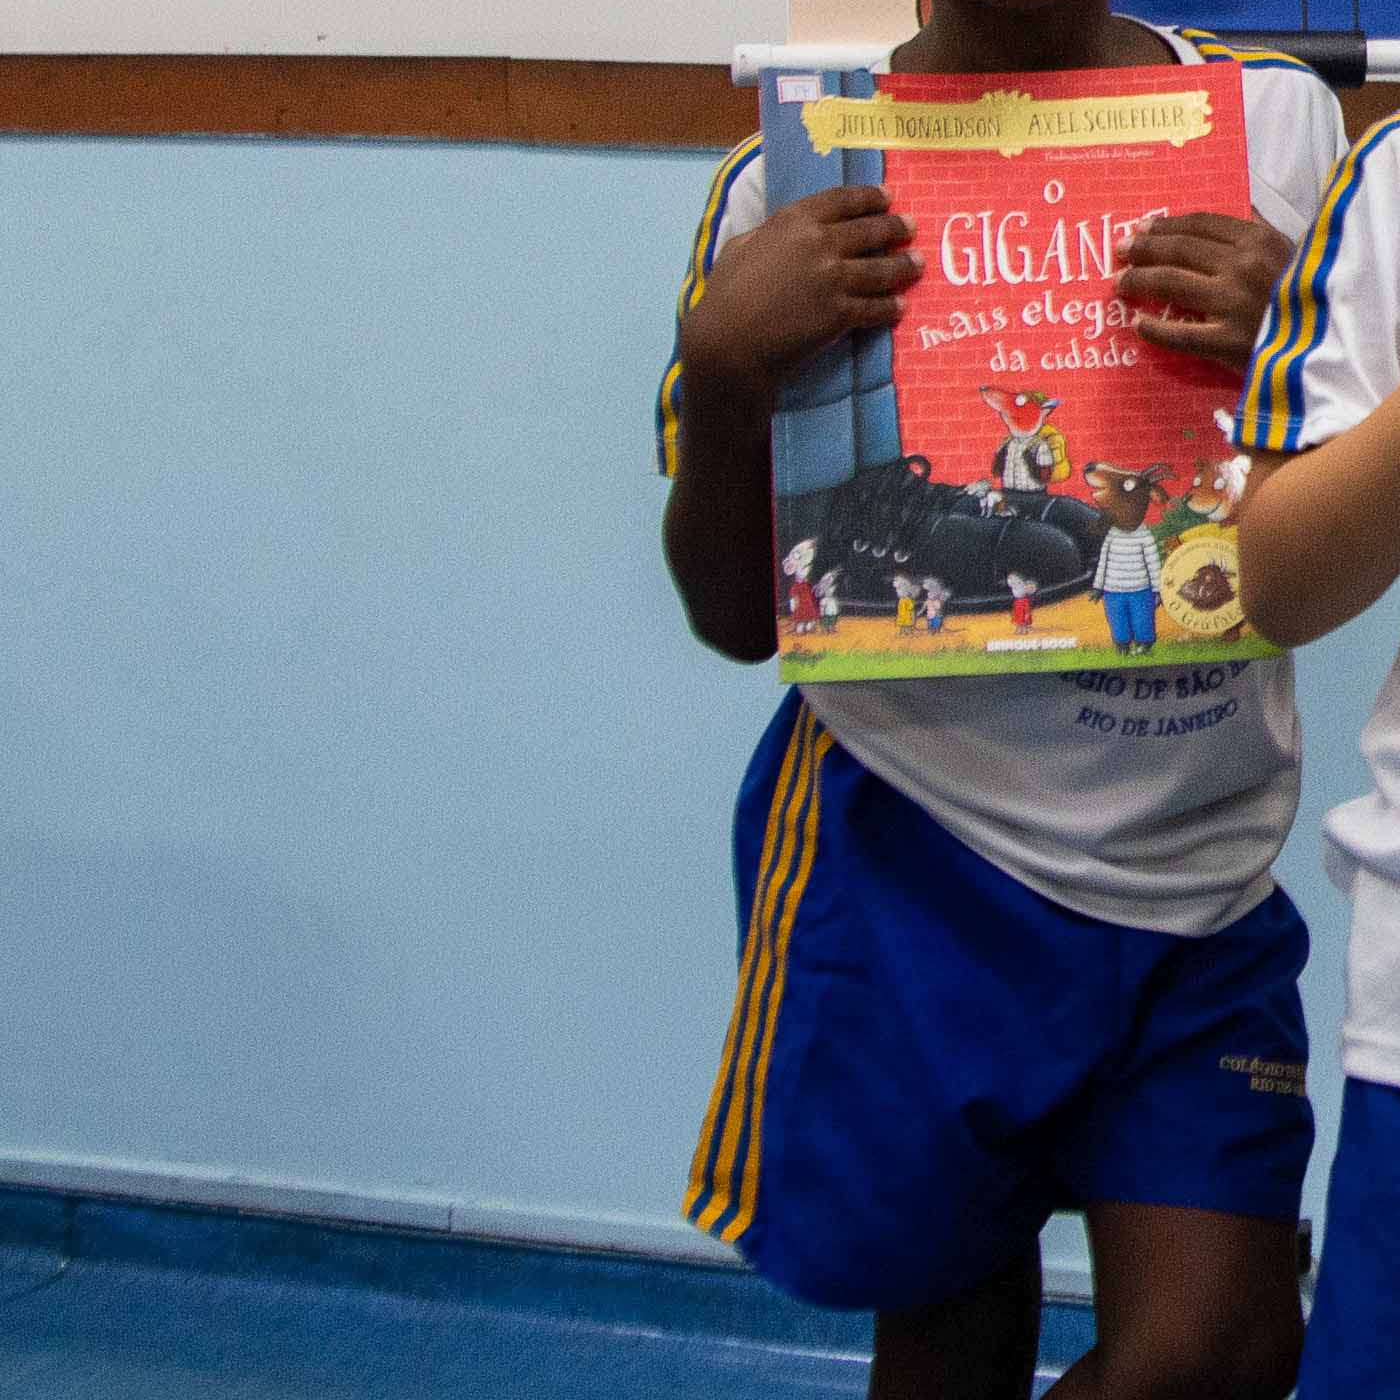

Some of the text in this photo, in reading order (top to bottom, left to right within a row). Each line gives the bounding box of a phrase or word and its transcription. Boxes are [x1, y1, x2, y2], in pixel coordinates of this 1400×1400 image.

[836, 115, 1000, 139] JULIA DONALDSON
[1028, 107, 1185, 137] AXEL SCHEFFLER
[919, 290, 1007, 351] mais
[990, 336, 1139, 373] da cidade
[1076, 698, 1238, 738] RIO DE JANEIRO
